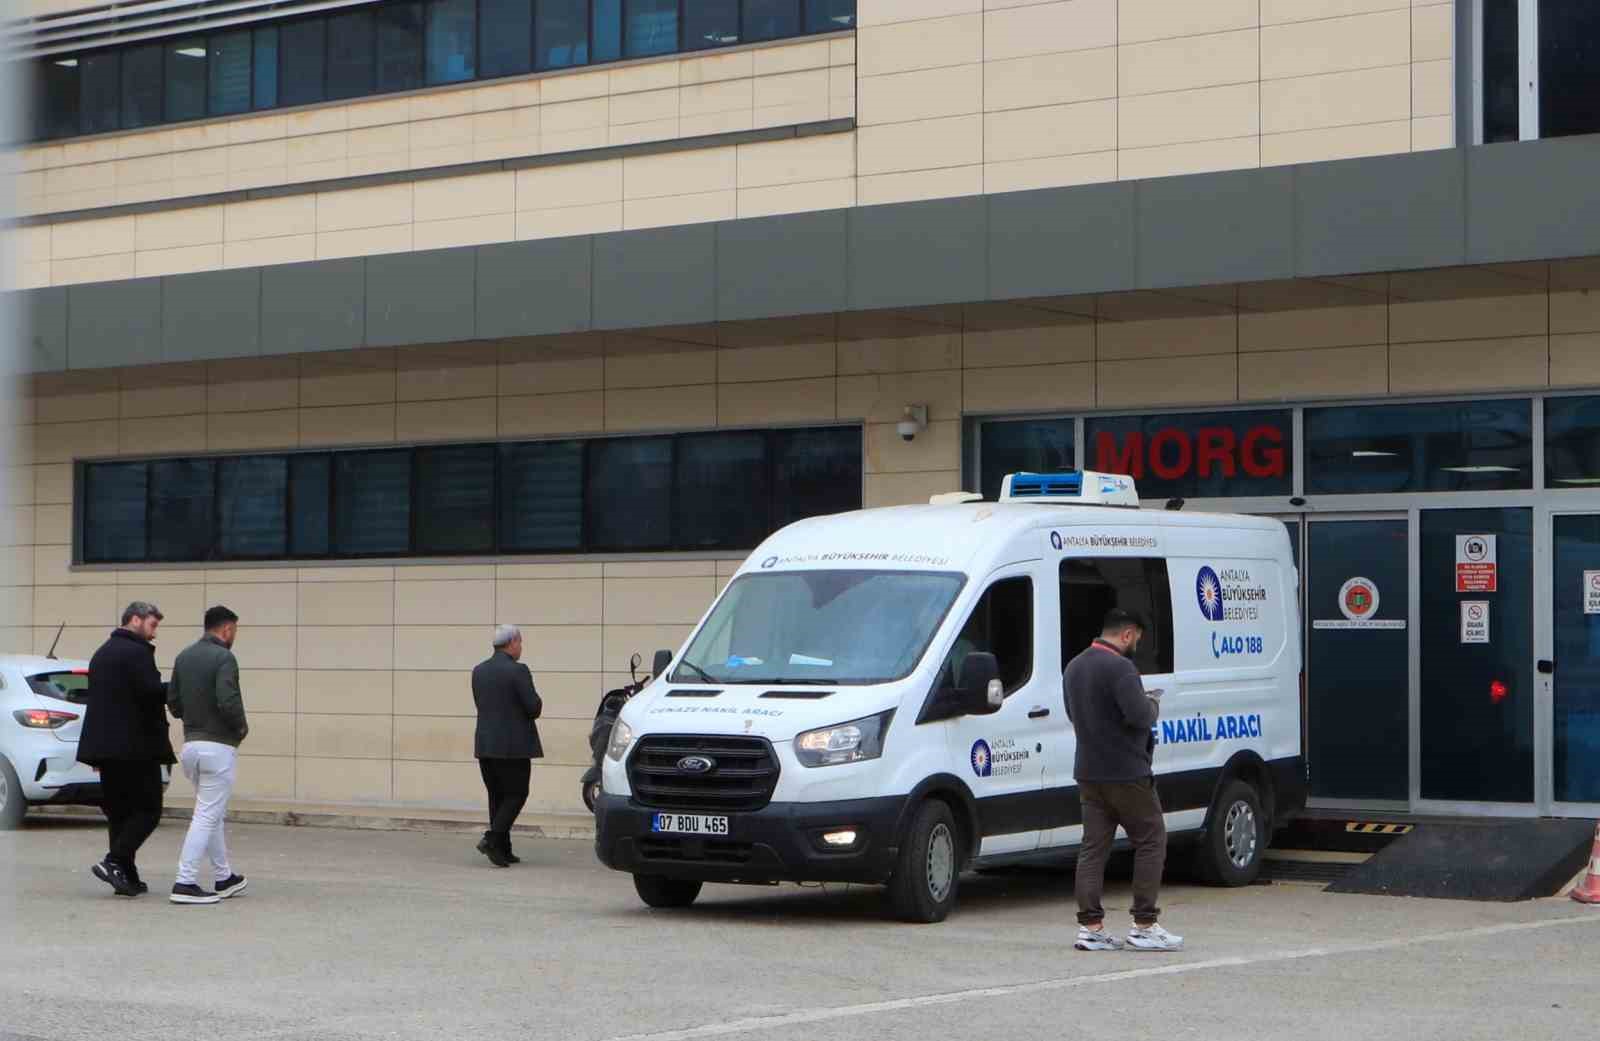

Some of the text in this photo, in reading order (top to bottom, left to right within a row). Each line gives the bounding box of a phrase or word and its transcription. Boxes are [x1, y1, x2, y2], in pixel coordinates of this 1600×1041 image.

[1095, 425, 1285, 480] MORG
[1063, 536, 1089, 546] ANTALYA
[1220, 569, 1250, 582] ANTALYA
[1221, 636, 1263, 654] ALO 188
[741, 708, 784, 717] ARACI
[1162, 712, 1212, 744] NAKİL
[1216, 714, 1262, 740] ARACI
[660, 815, 672, 830] 07
[678, 816, 699, 831] BDU
[705, 817, 726, 833] 465
